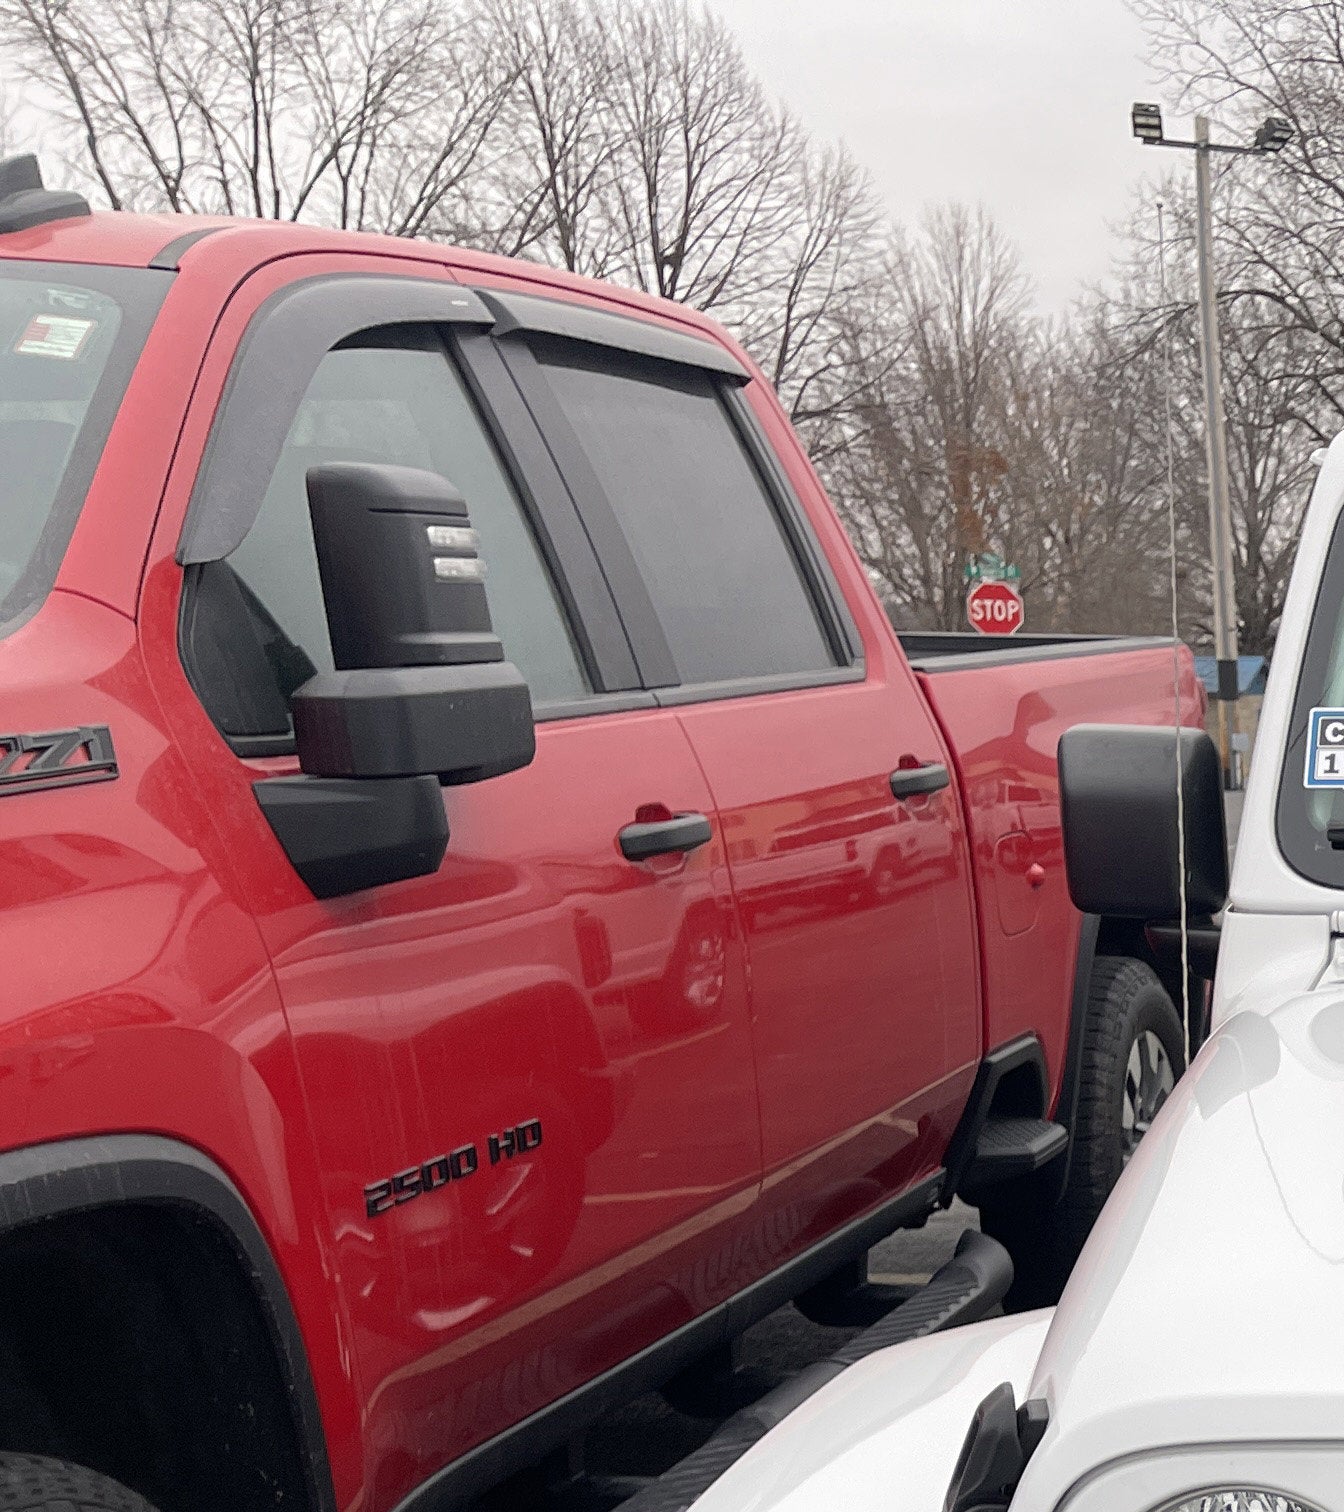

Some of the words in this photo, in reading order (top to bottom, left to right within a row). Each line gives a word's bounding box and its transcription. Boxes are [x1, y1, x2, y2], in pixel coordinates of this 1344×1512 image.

[971, 598, 1019, 622] STOP
[364, 1142, 478, 1219] 2500
[488, 1117, 542, 1166] HD
